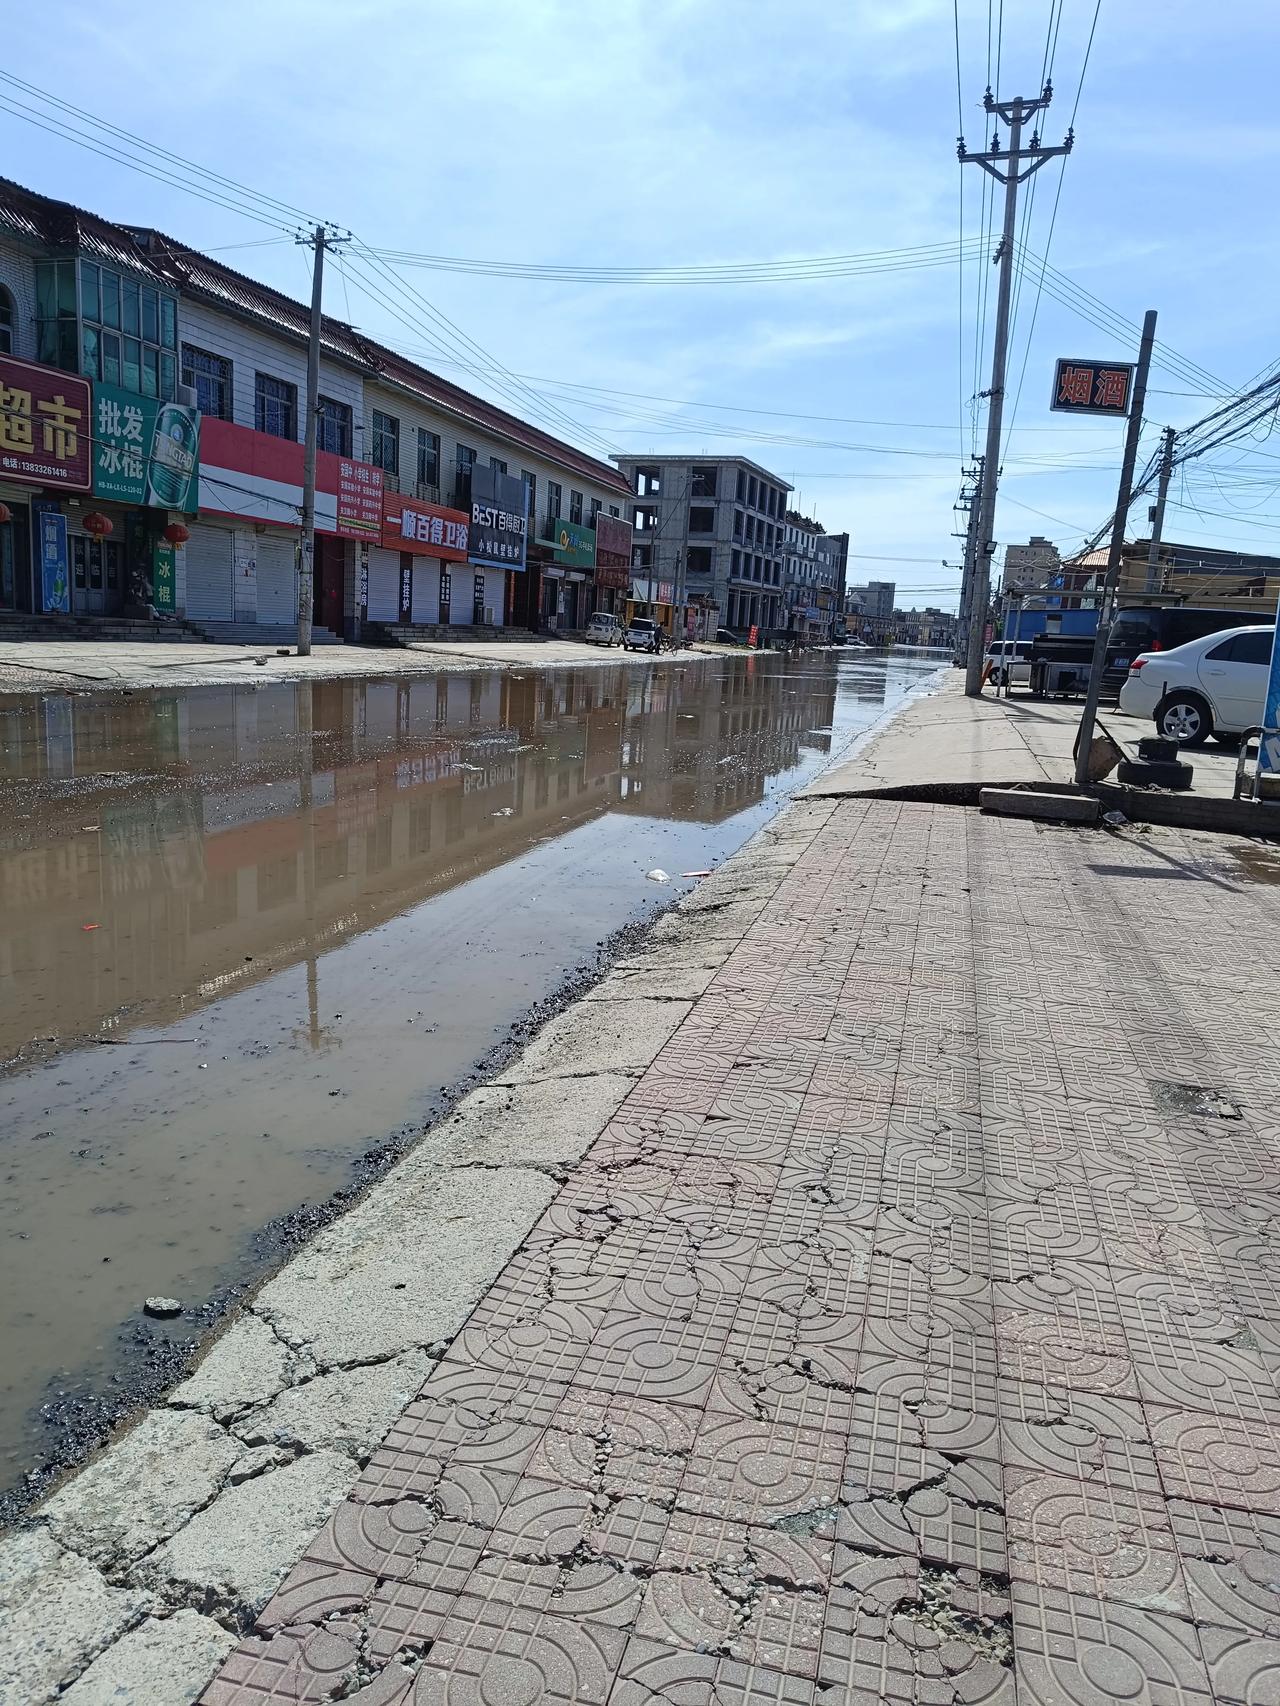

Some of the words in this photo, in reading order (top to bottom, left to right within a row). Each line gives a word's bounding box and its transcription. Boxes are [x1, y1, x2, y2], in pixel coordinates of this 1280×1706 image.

[1059, 367, 1128, 407] 烟酒
[0, 380, 82, 460] 超市
[98, 398, 144, 442] 批发
[98, 439, 144, 479] 冰棍
[155, 433, 193, 469] TNGTAO
[158, 561, 171, 603] 冰棍
